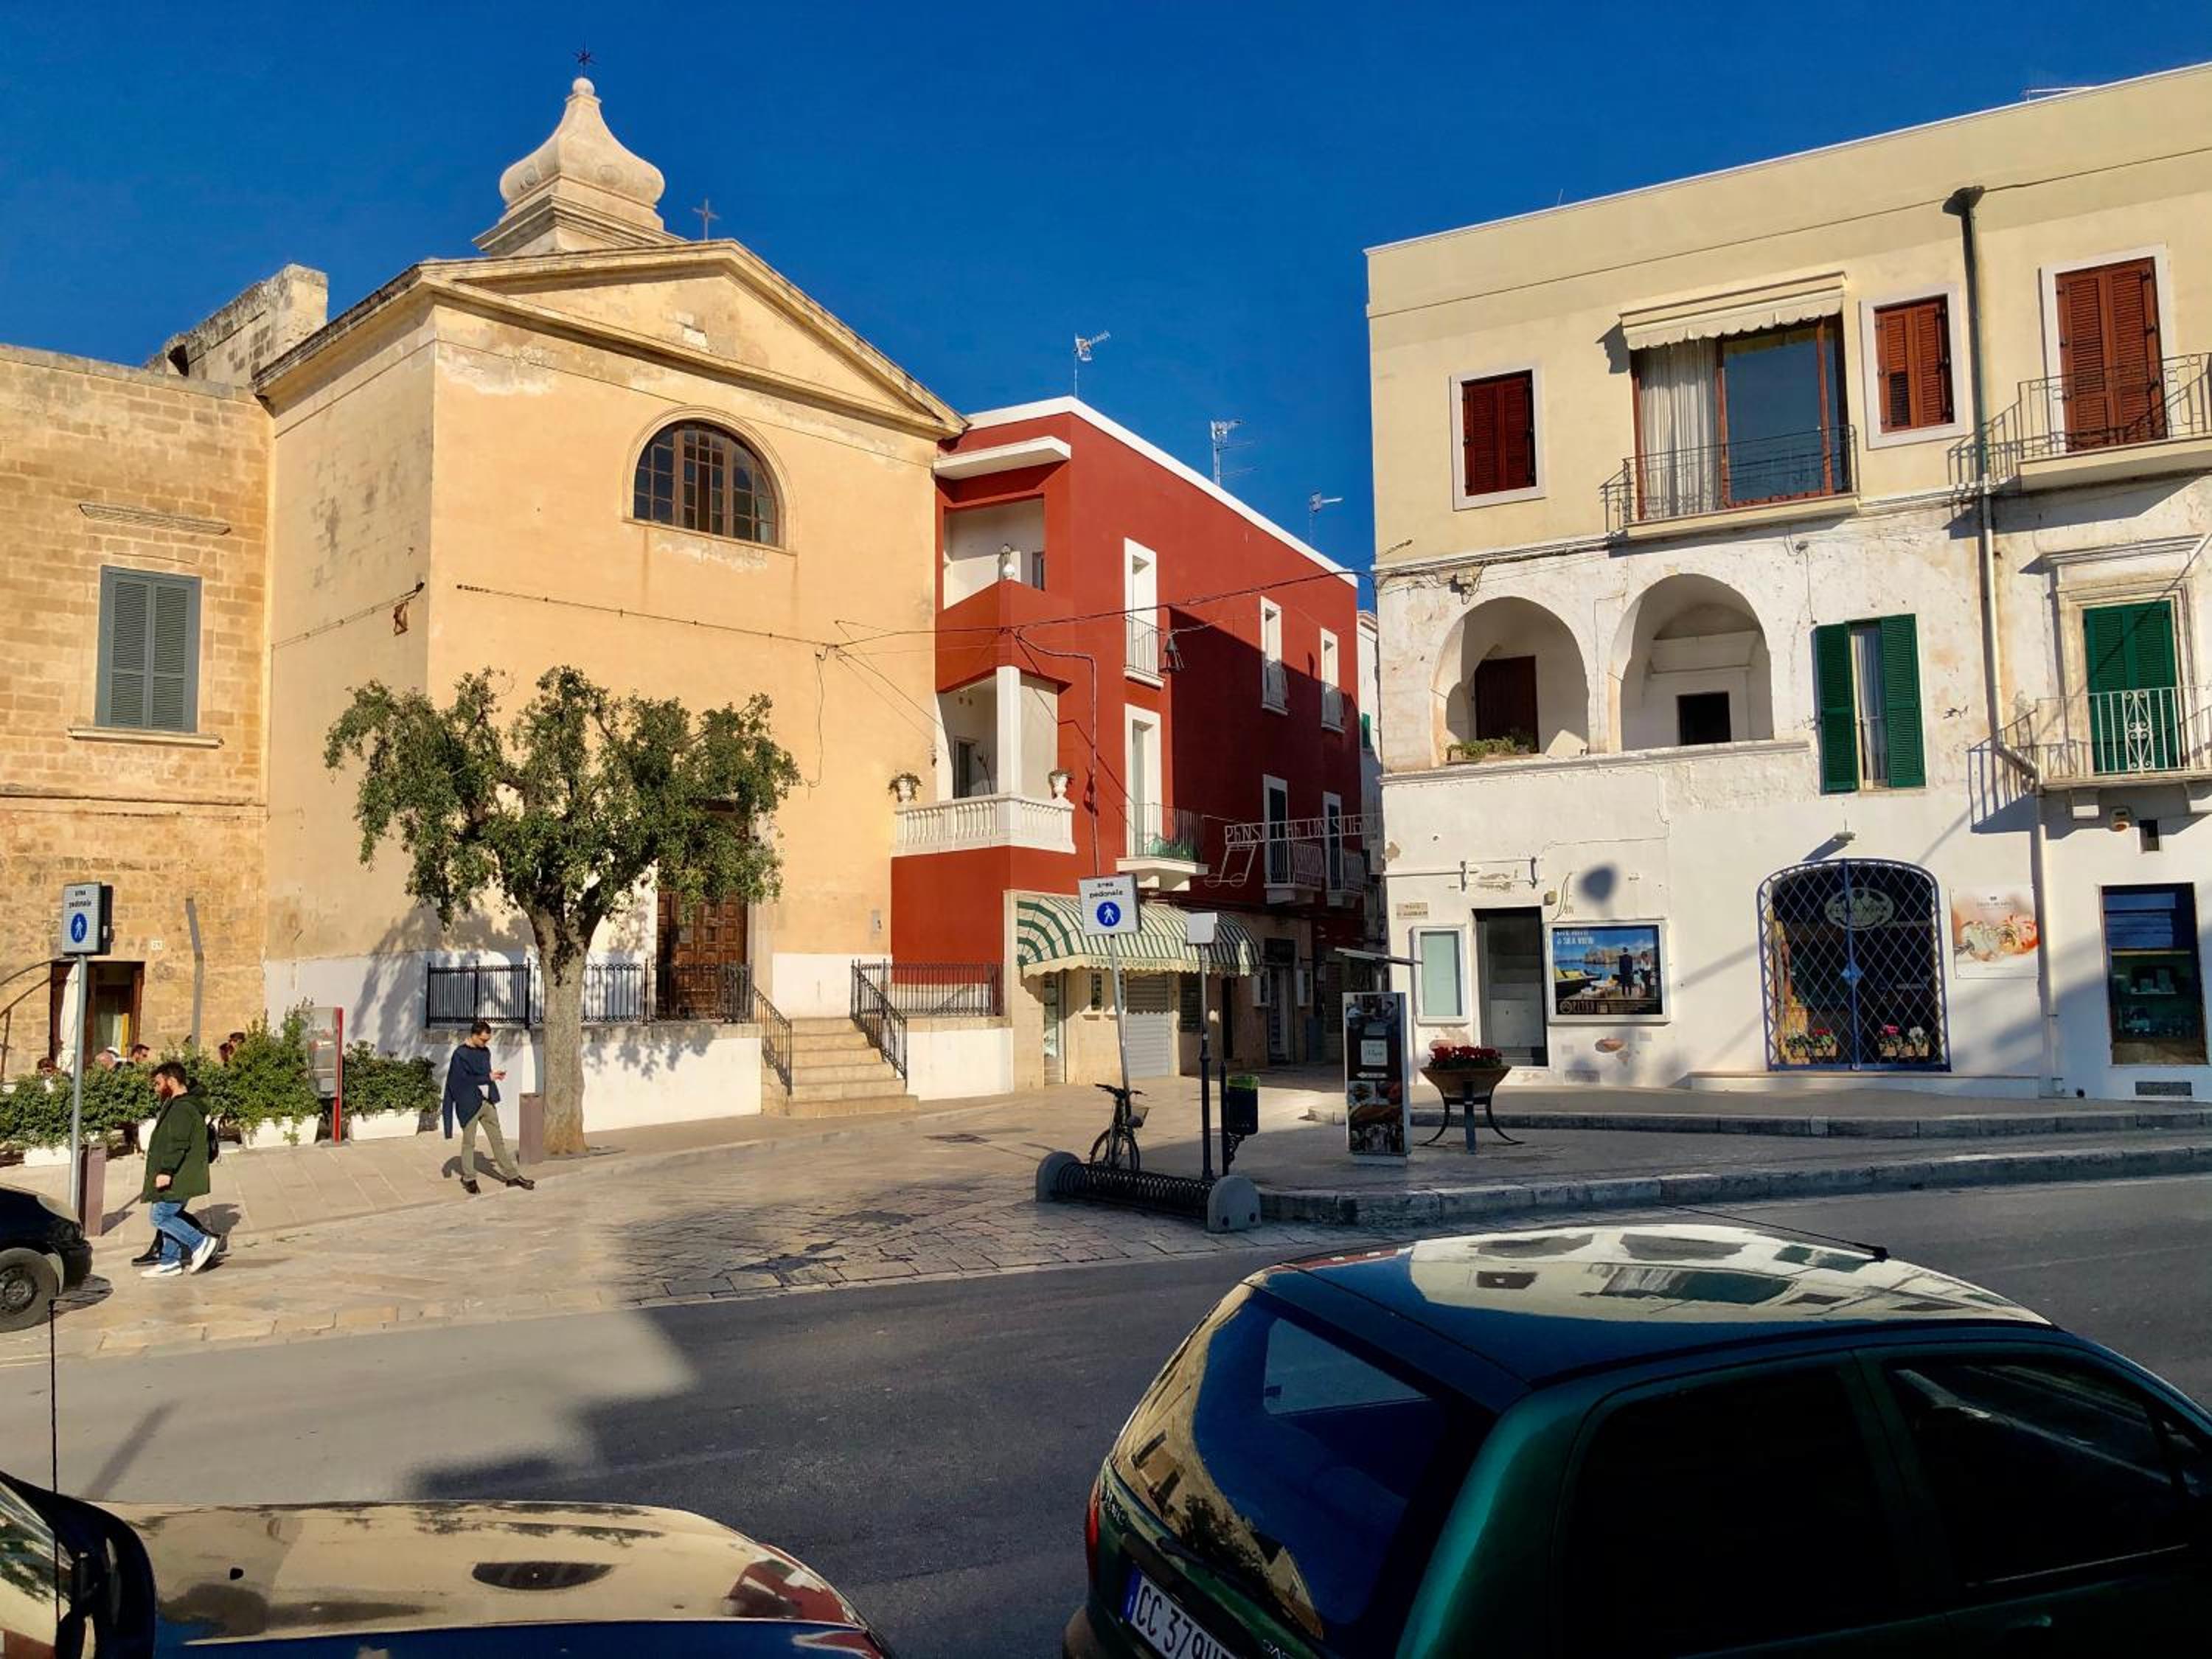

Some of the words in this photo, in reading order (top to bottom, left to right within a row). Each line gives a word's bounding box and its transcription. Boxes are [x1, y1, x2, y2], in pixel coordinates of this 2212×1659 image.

[1089, 889, 1123, 898] pedonale
[1091, 958, 1116, 966] LENT
[1126, 959, 1171, 968] CONTATTO
